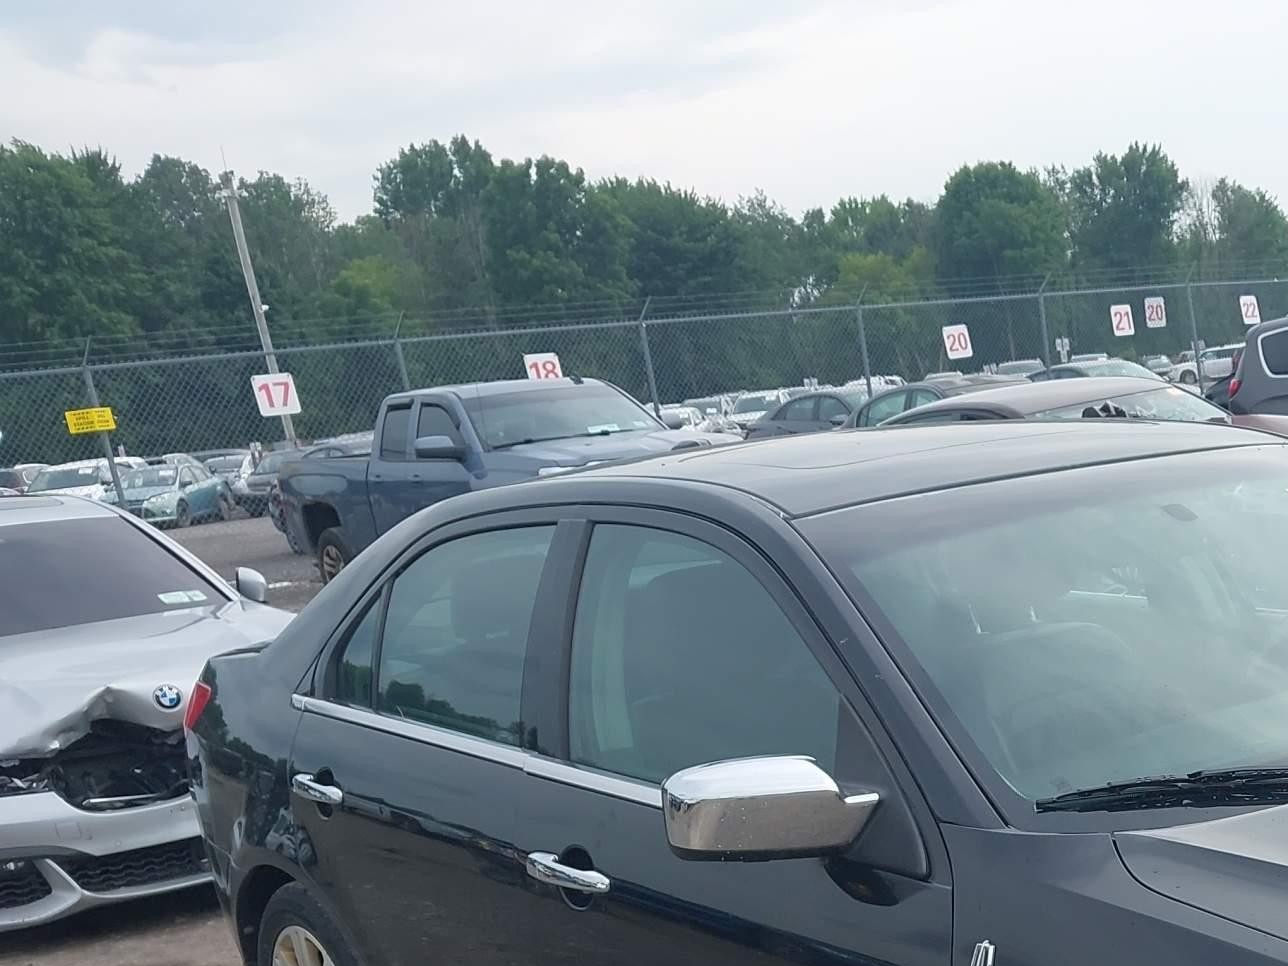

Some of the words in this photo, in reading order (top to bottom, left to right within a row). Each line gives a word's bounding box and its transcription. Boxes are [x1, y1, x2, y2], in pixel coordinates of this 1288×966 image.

[1147, 304, 1163, 321] 20
[1243, 302, 1257, 318] 22
[1114, 311, 1131, 330] 21
[947, 332, 968, 352] 20
[529, 361, 559, 379] 18
[258, 381, 289, 408] 17
